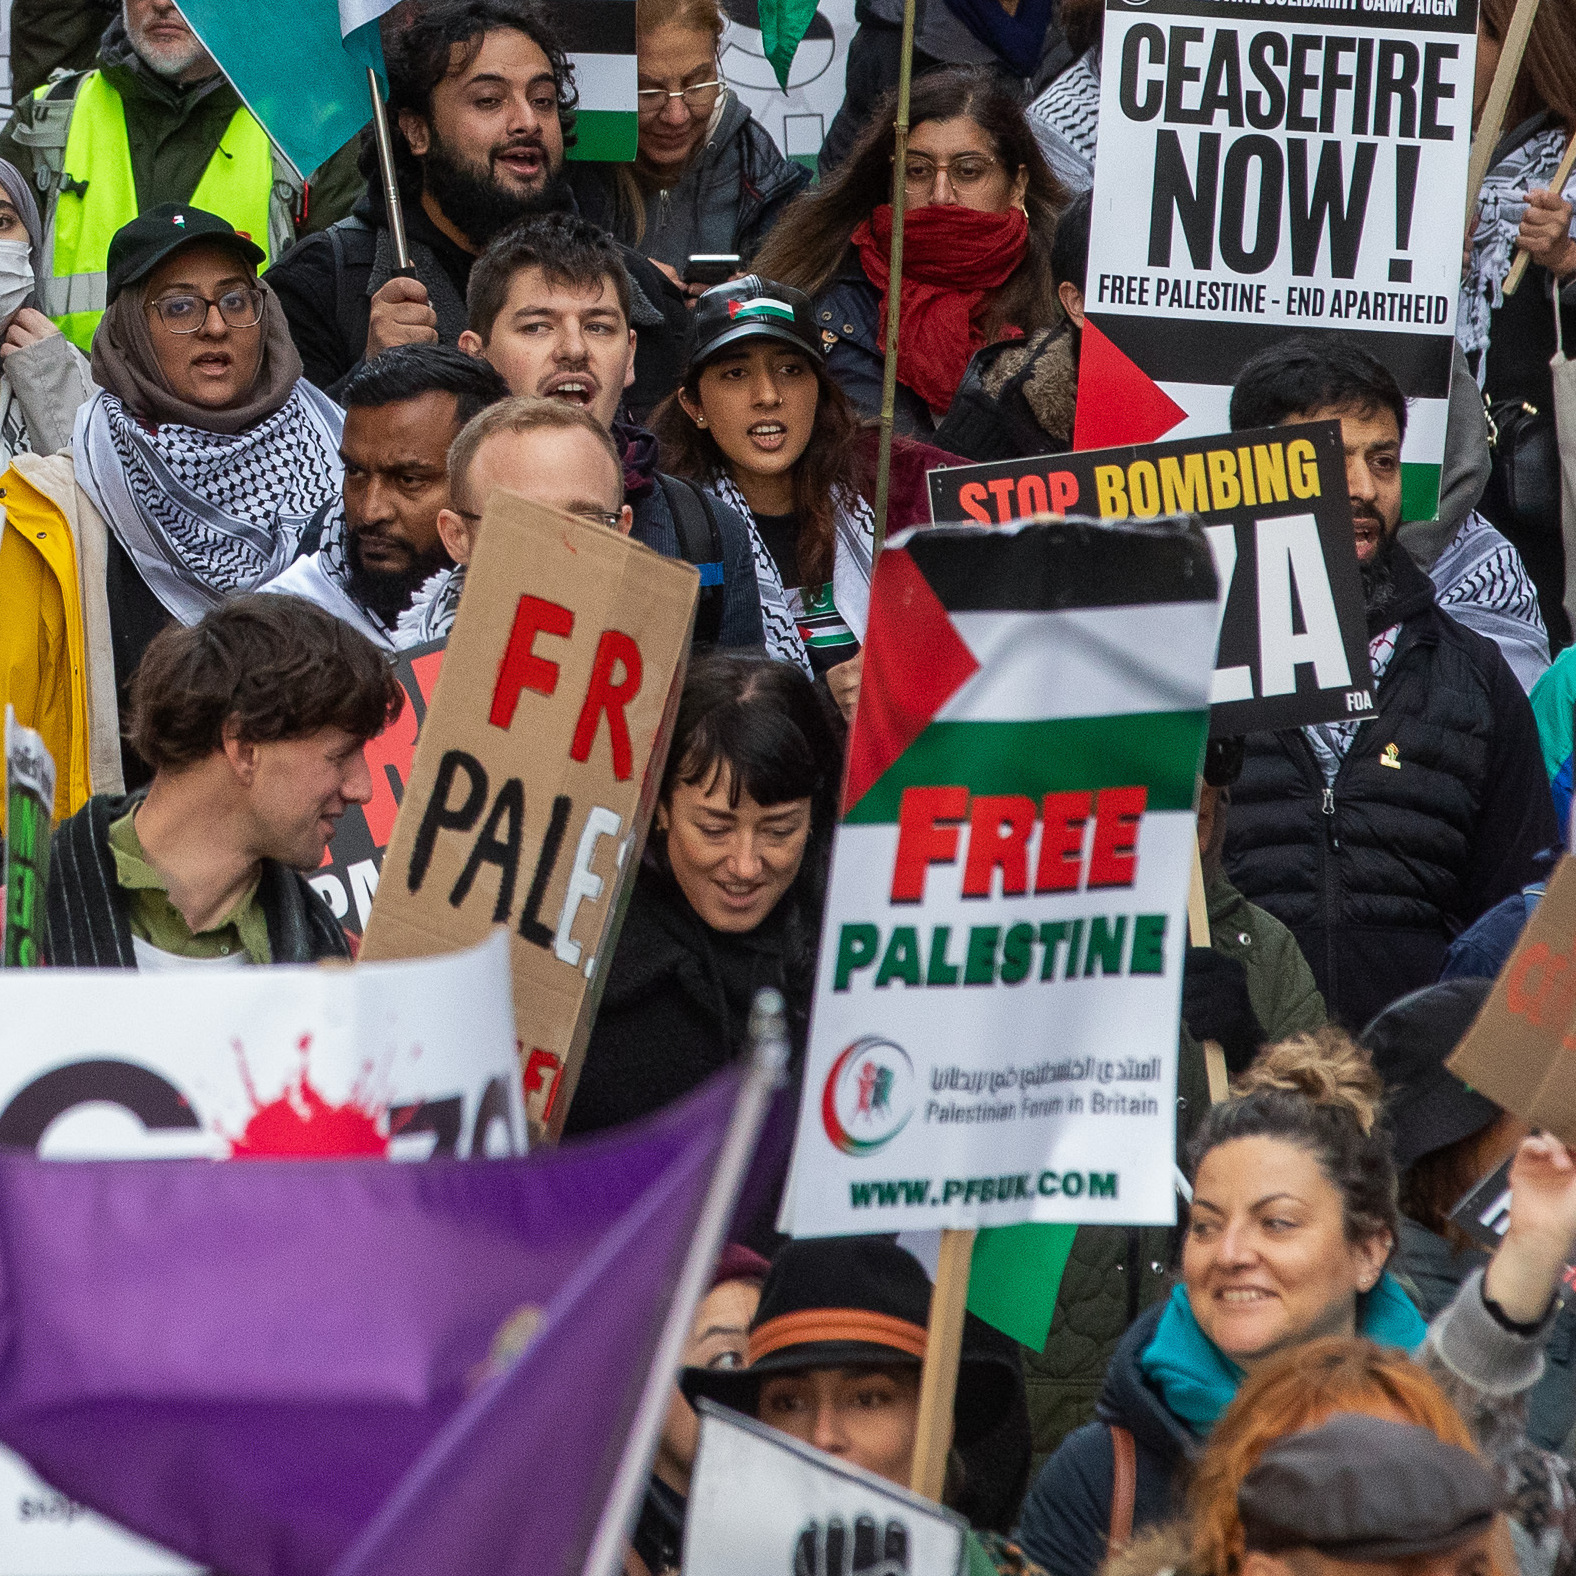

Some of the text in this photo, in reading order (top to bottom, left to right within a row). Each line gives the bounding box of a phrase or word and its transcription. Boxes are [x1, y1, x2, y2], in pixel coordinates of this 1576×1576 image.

[1119, 22, 1460, 142] CEASEFIRE
[1098, 273, 1449, 325] FREE PALESTINE END APARTHEID
[959, 438, 1322, 527] STOP BOMBING
[1346, 691, 1373, 713] FOA
[888, 785, 1150, 906] FREE
[833, 913, 1170, 993] PALESTINE
[1067, 1094, 1084, 1113] in
[1091, 1090, 1159, 1116] Britain
